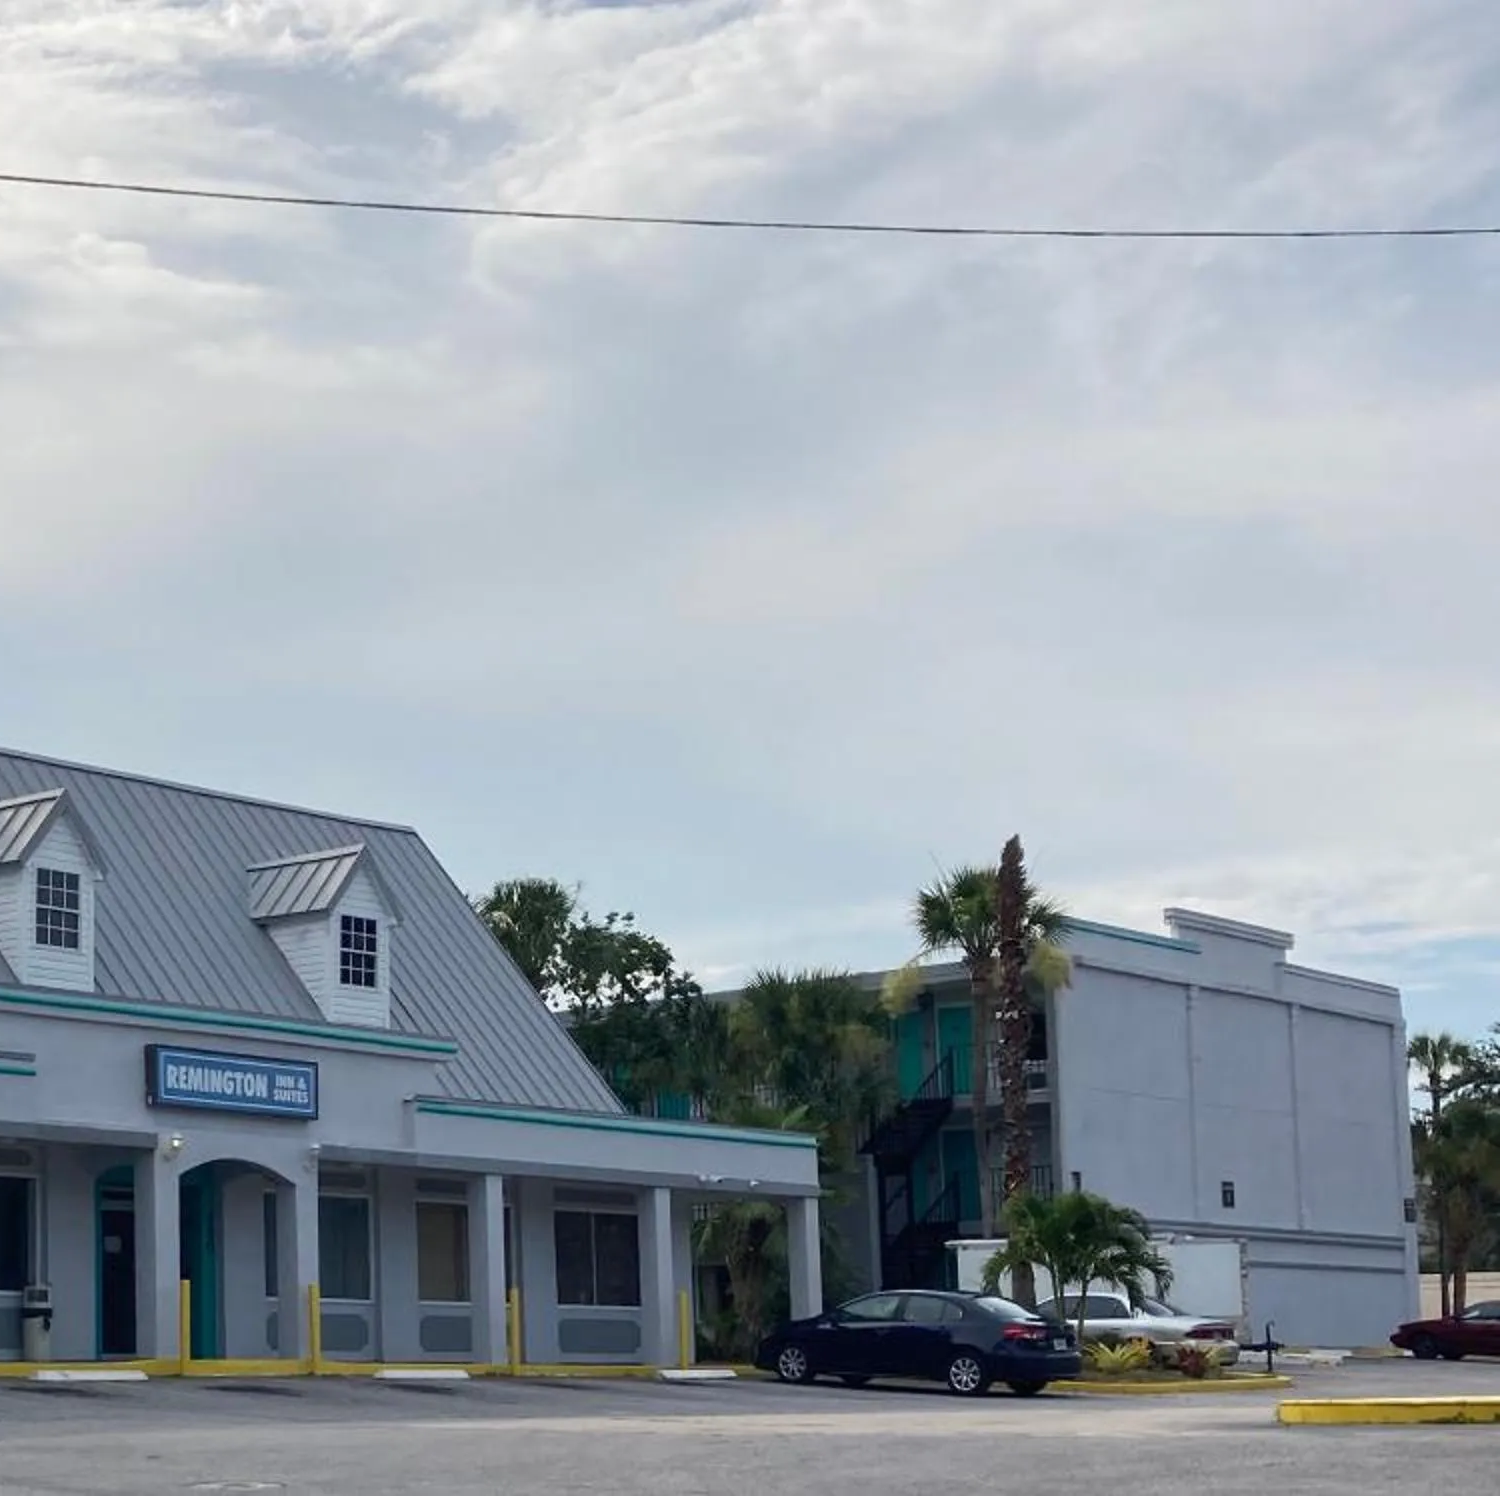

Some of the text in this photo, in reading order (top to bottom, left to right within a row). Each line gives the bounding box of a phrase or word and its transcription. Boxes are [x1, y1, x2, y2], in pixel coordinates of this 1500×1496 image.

[166, 1064, 268, 1098] REMINGTON
[275, 1074, 307, 1090] INN &
[273, 1089, 309, 1103] SUITES
